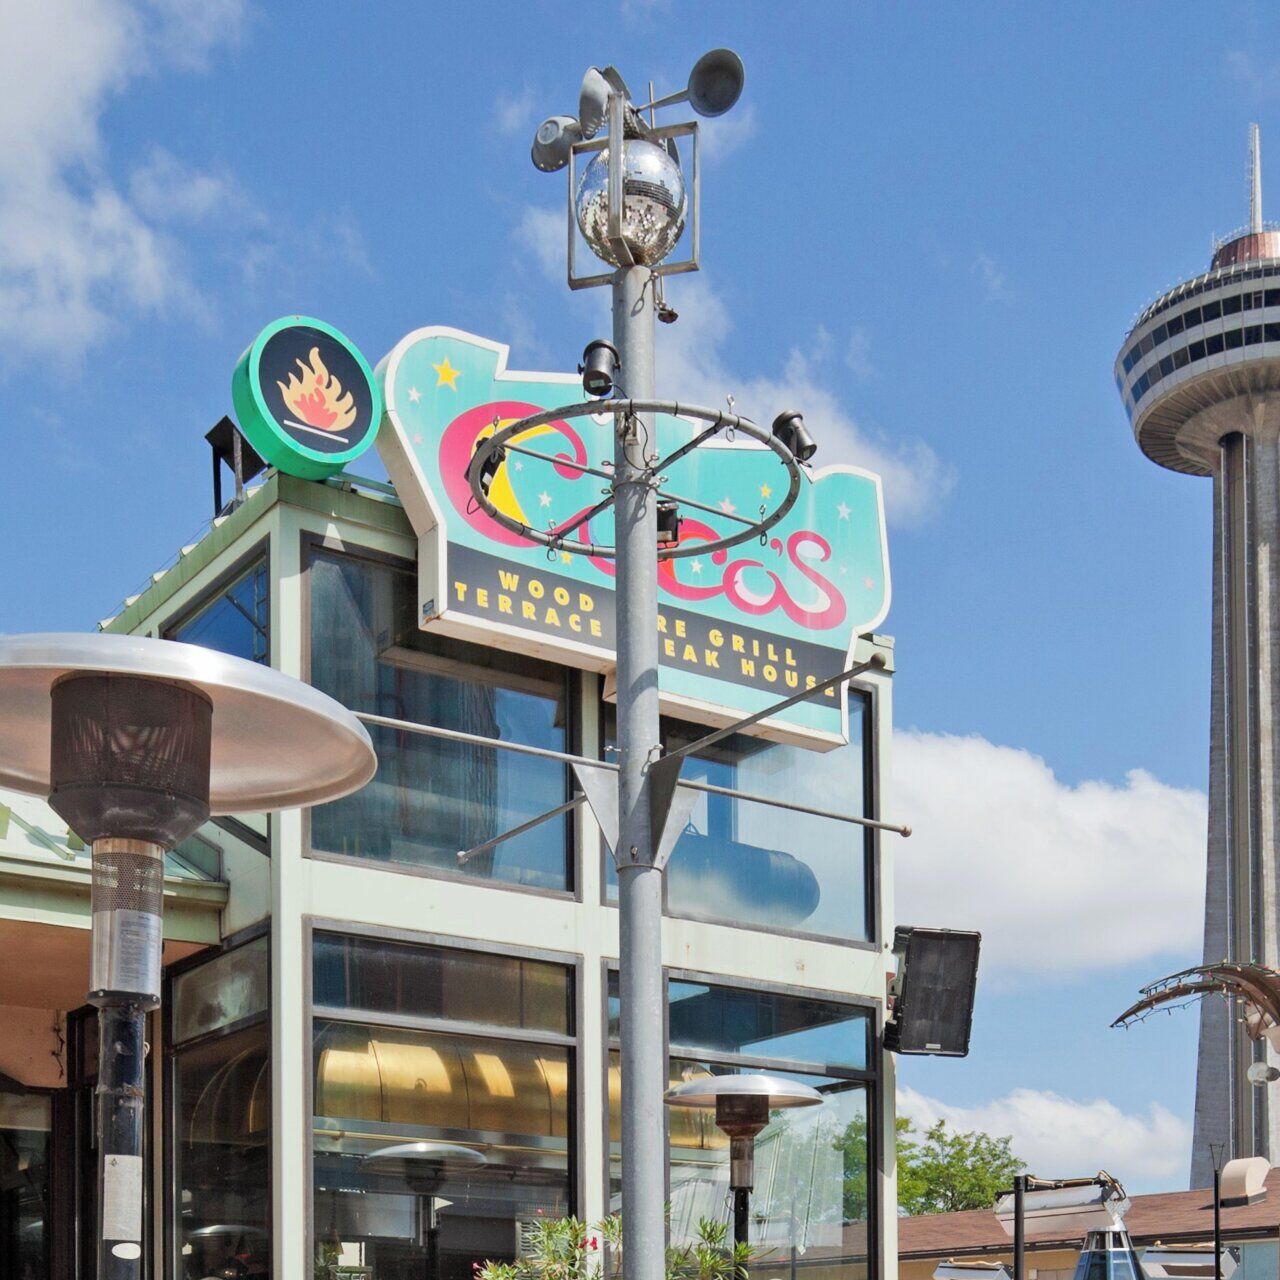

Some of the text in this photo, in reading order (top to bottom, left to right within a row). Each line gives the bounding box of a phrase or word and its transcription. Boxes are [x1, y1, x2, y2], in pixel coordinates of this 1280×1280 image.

[454, 581, 602, 638] TERRACE
[664, 637, 720, 669] EAK
[498, 569, 797, 667] WOOD RE GRILL
